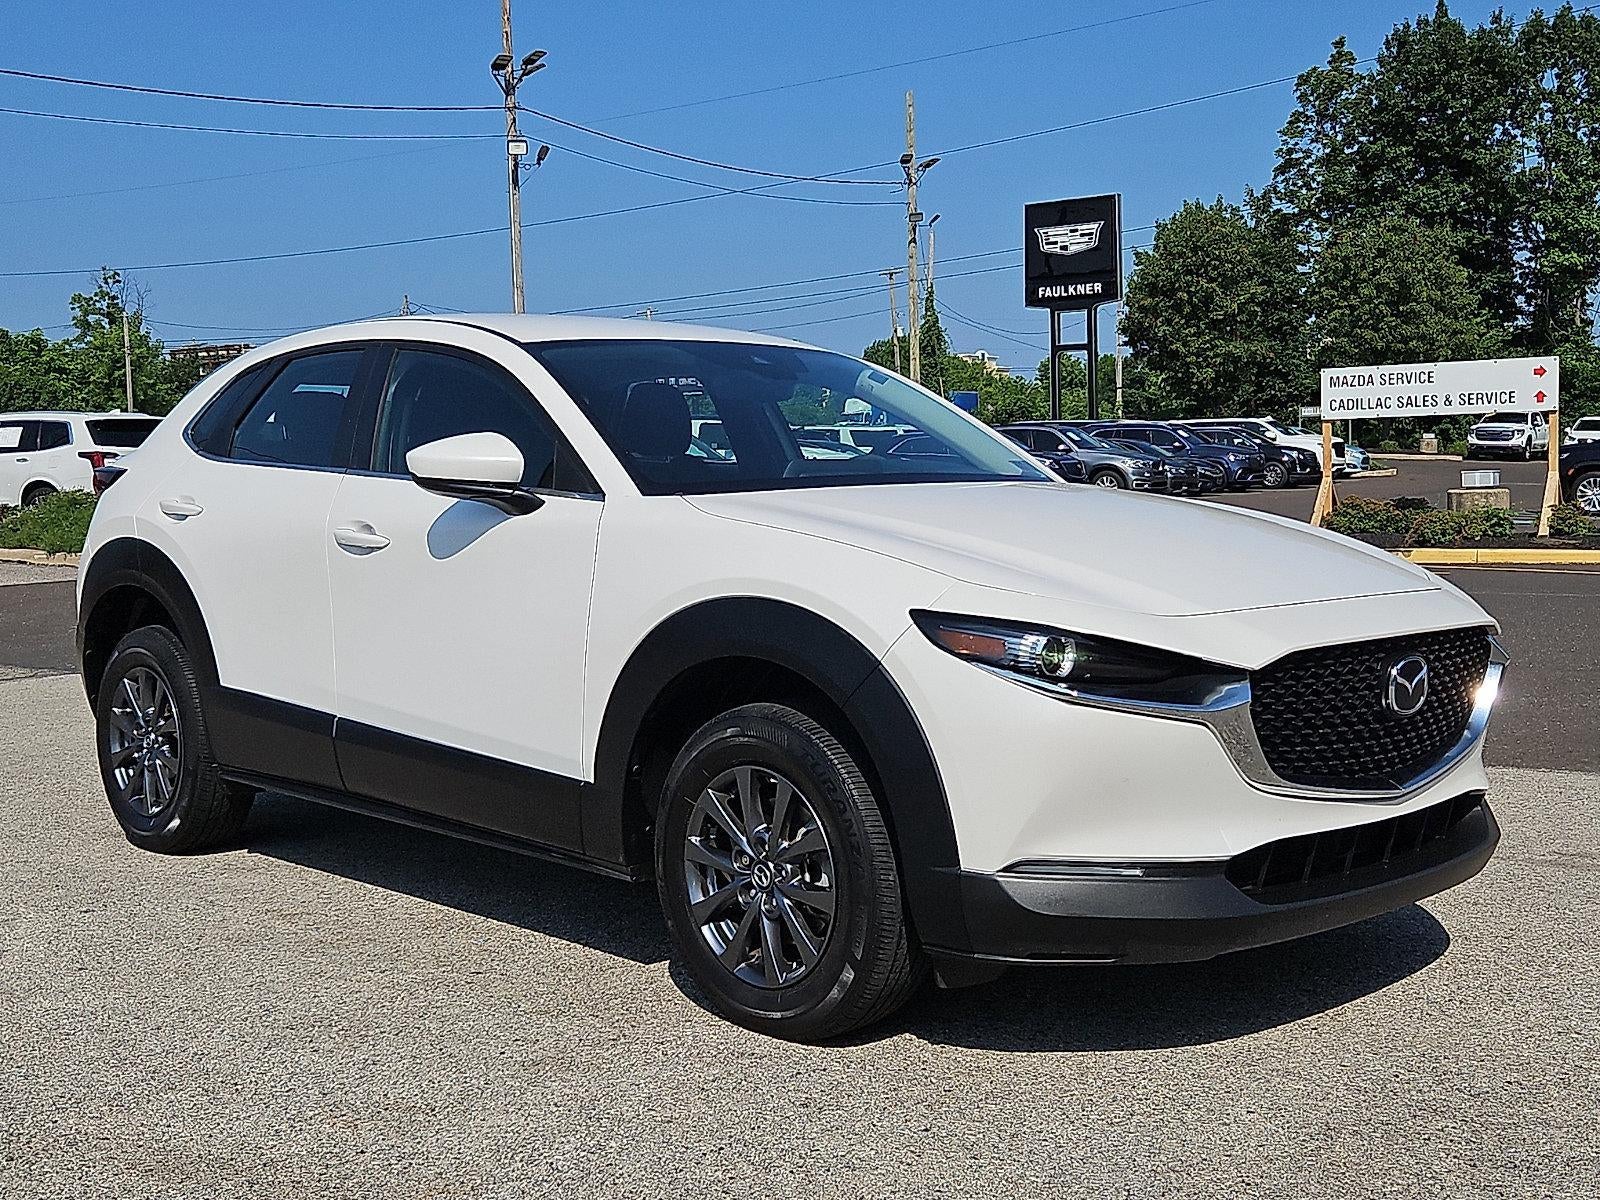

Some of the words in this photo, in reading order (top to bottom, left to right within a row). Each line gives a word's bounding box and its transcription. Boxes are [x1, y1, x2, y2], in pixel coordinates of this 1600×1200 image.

[1038, 282, 1102, 298] FAULKNER
[1329, 374, 1375, 388] MAZDA
[1379, 371, 1434, 386] SERVICE
[1329, 396, 1392, 411] CADILLAC
[1396, 394, 1439, 408] SALES
[1443, 393, 1453, 406] &
[1458, 391, 1516, 405] SERVICE
